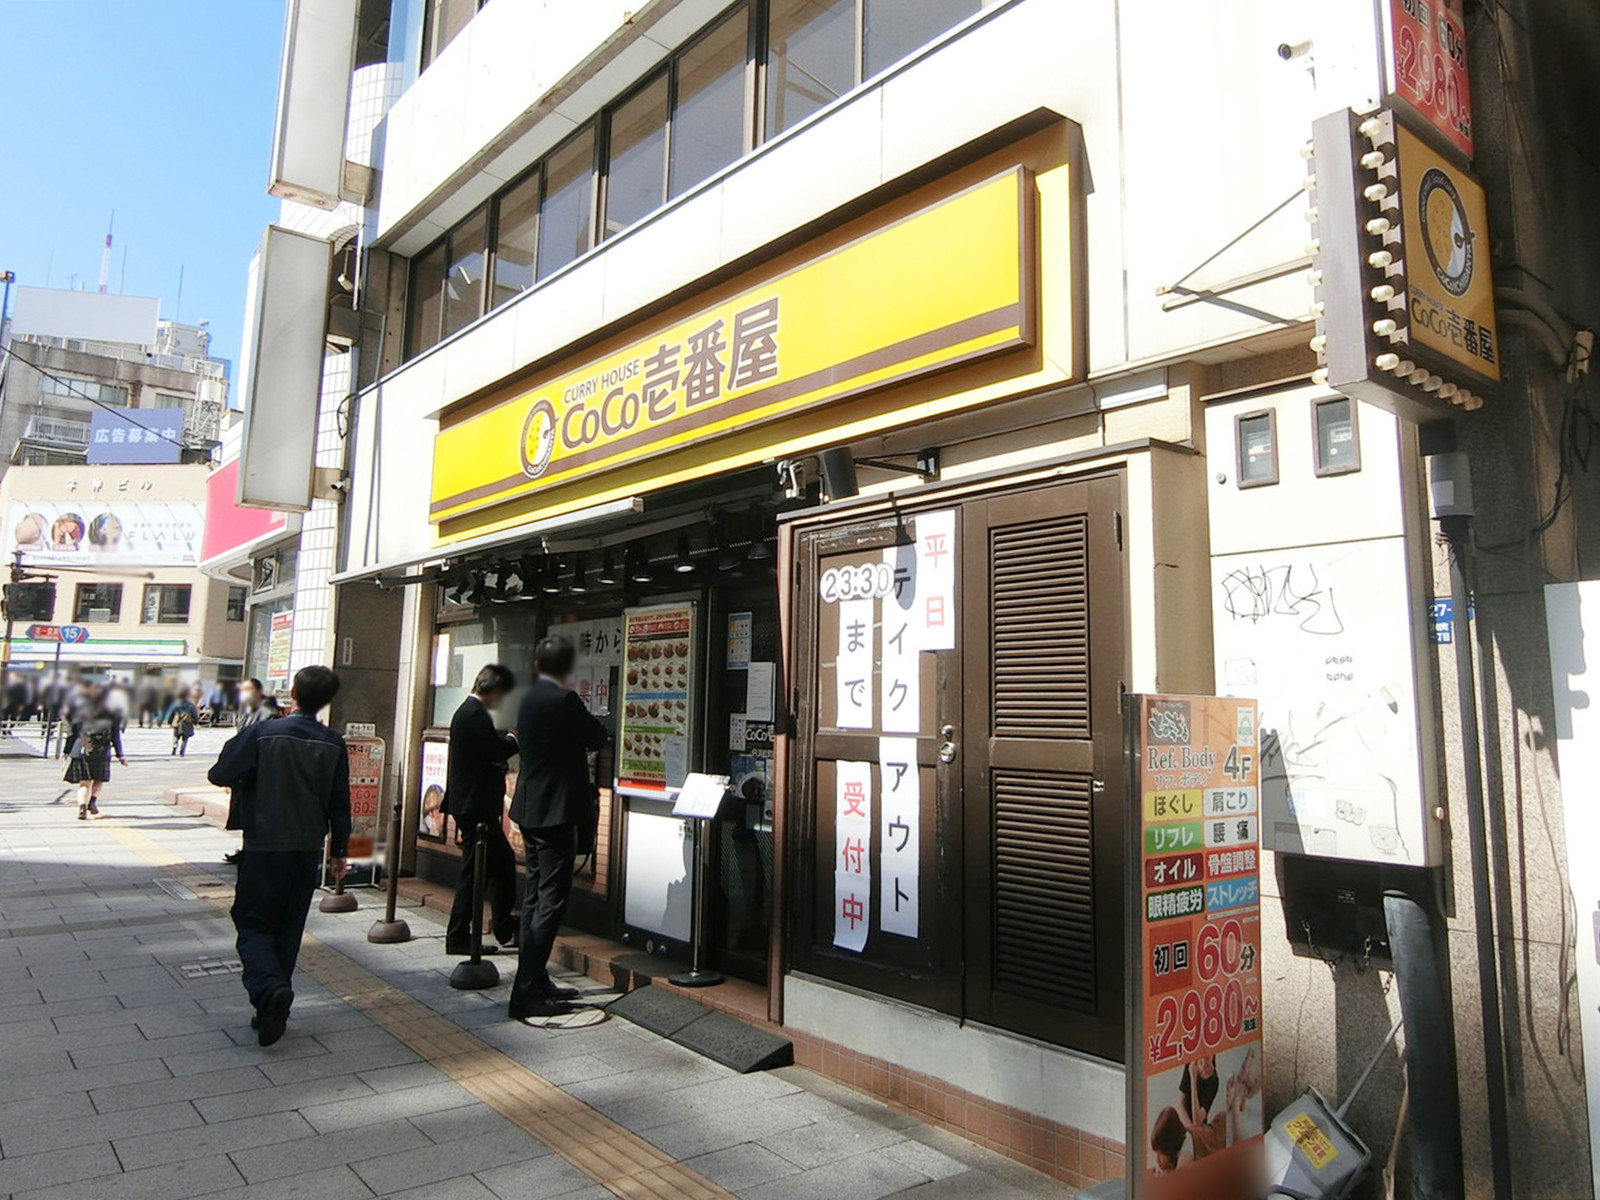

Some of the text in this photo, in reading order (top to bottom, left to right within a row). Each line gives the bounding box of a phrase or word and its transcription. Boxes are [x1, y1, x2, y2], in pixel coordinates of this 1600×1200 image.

[561, 296, 780, 450] CoCo壱番屋
[563, 358, 641, 405] CURRY HOUSE
[93, 426, 178, 445] 広告募集中
[824, 569, 895, 601] 23:30
[924, 532, 949, 628] 平日
[63, 627, 78, 639] 15
[844, 618, 867, 709] まで
[887, 567, 912, 914] テイクアウト
[1148, 746, 1217, 773] Ref. Body
[1223, 744, 1252, 782] 4F
[1153, 794, 1194, 817] ほぐし
[1211, 790, 1249, 812] 肩こり
[1153, 827, 1194, 851] リフレ
[842, 780, 865, 931] 受付中
[1153, 859, 1197, 884] オイル
[1207, 851, 1257, 876] 骨盤調整
[1147, 887, 1204, 920] 眼精疲労
[1207, 881, 1258, 907] ストレッチ
[1153, 941, 1188, 976] 初回
[1196, 919, 1256, 983] 60分
